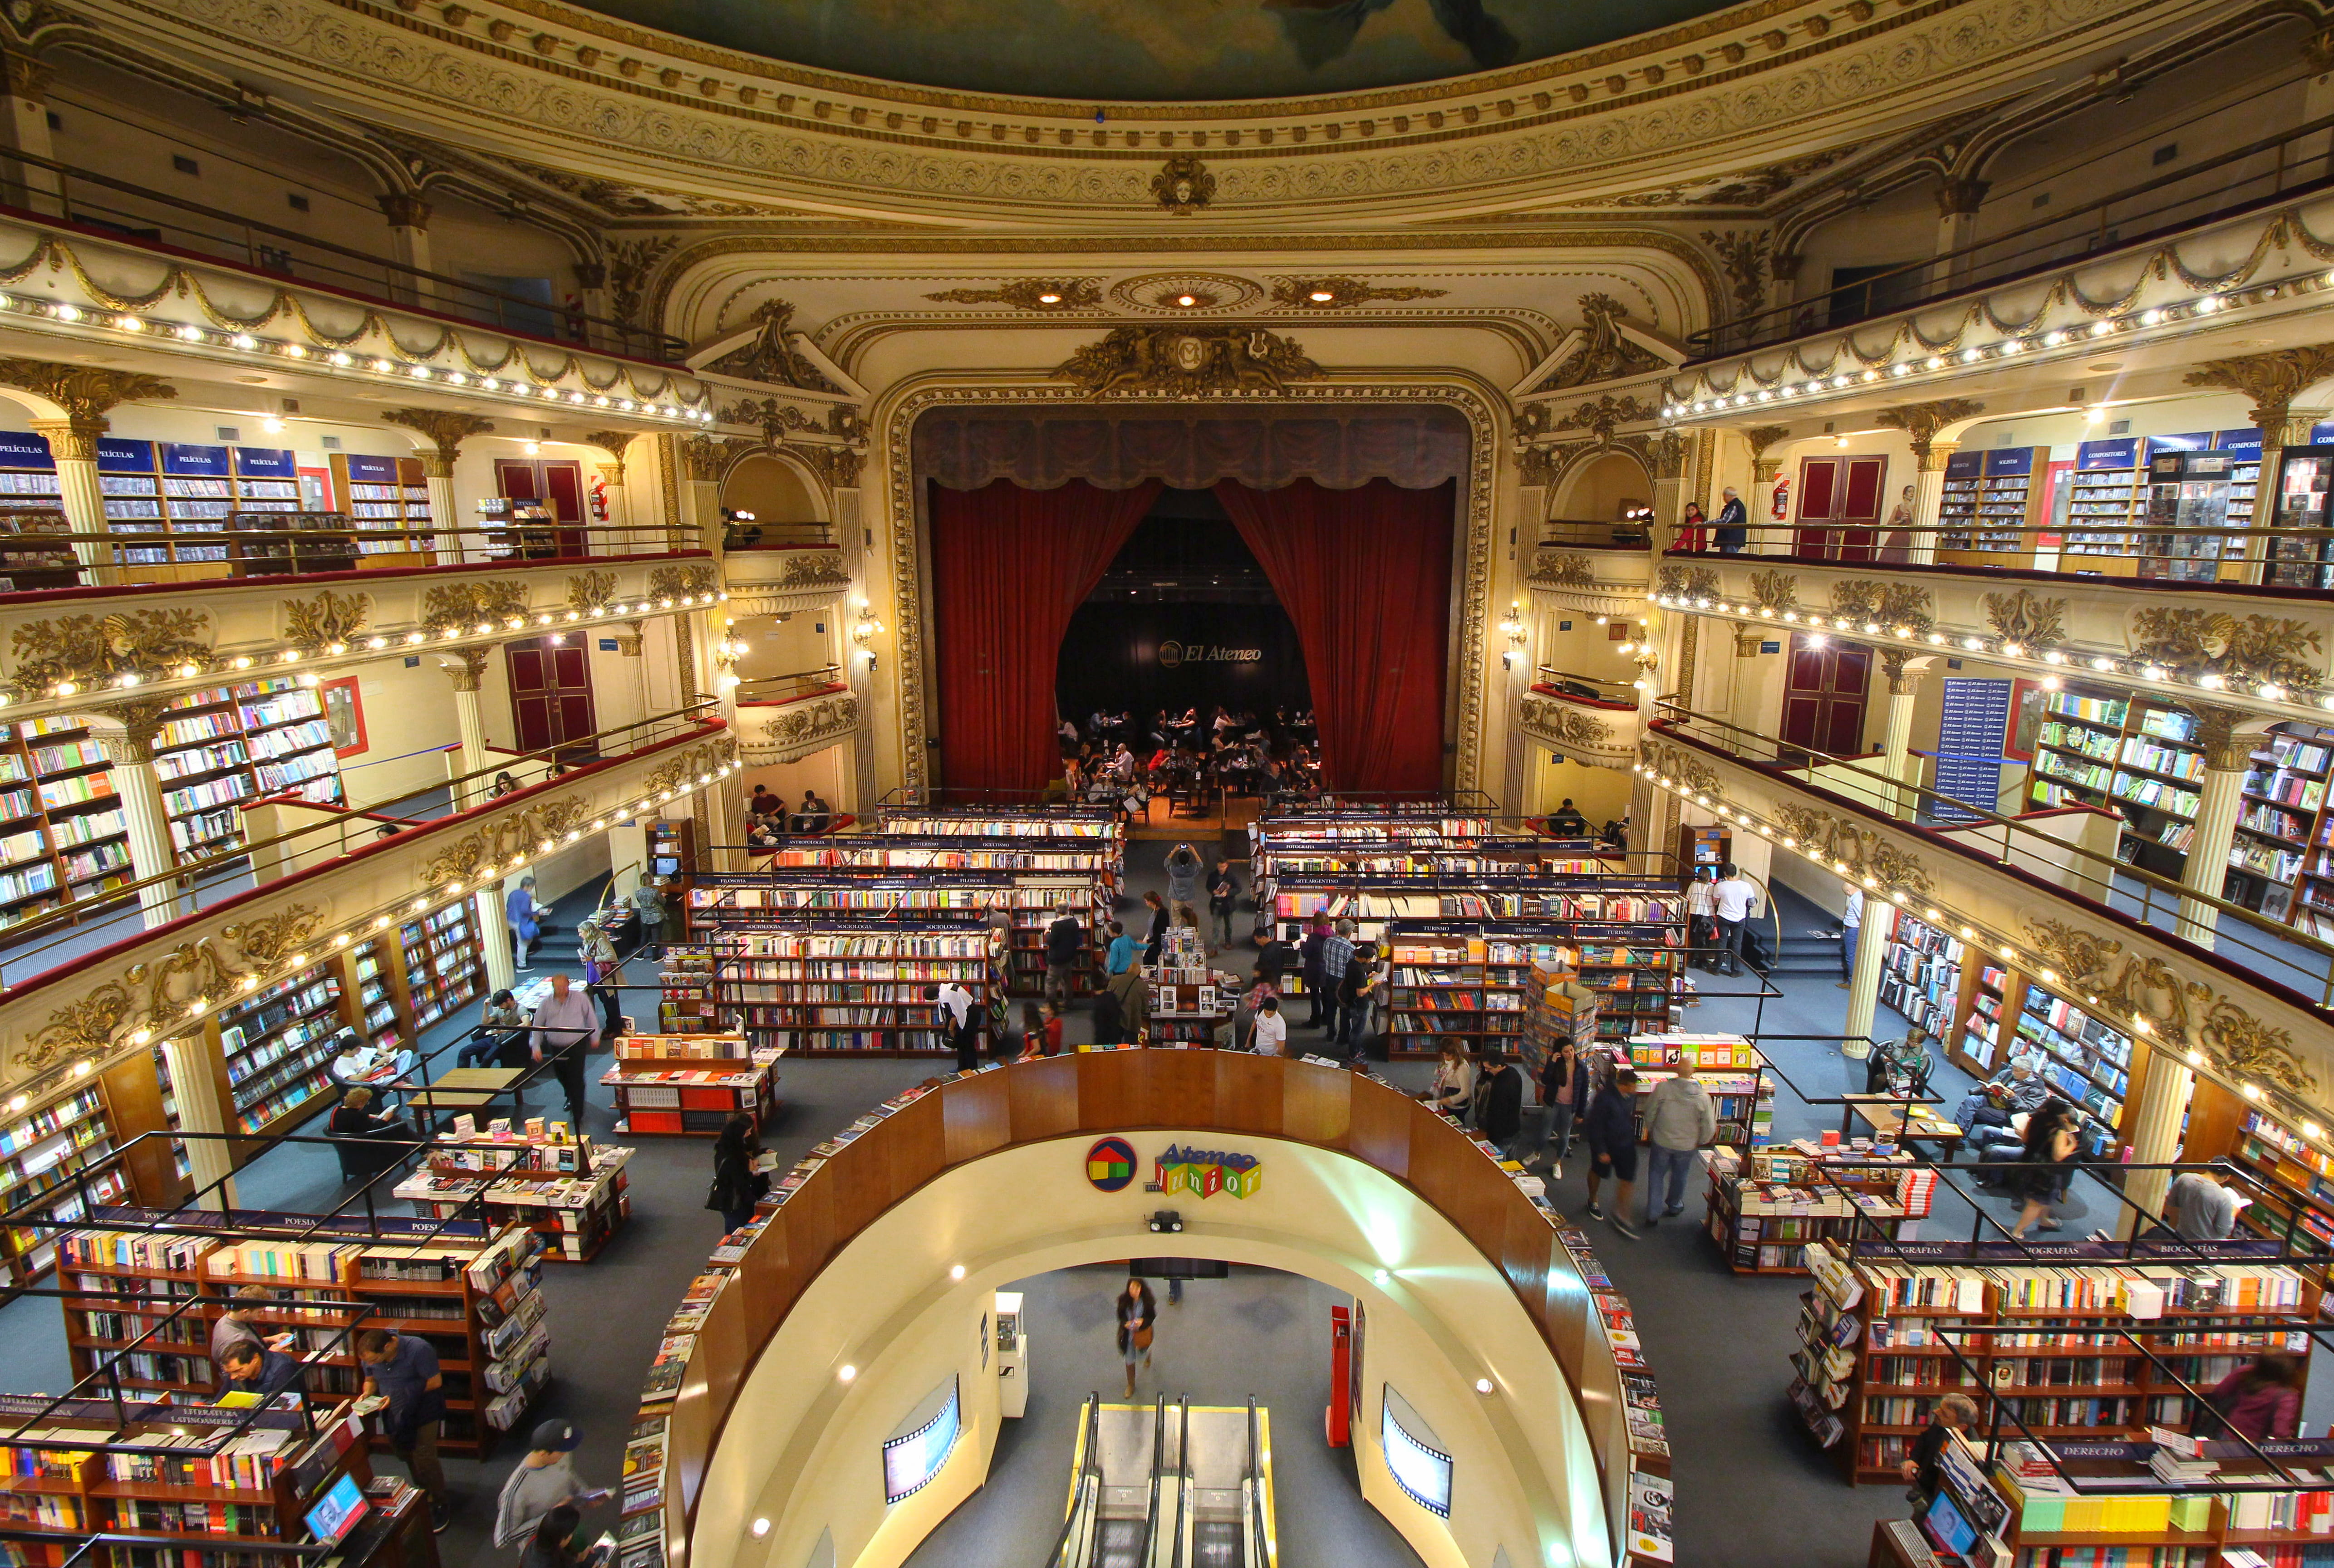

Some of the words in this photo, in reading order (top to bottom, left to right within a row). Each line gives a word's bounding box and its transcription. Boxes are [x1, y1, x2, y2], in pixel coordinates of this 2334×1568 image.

[0, 445, 42, 454] PELÍCULAS
[2154, 445, 2197, 453] COMPOSITORES
[2088, 451, 2127, 459] COMPOSITORES
[179, 456, 211, 464] PELÍCULAS
[1184, 647, 1203, 661] El
[1206, 645, 1261, 661] Ateneo
[1160, 1143, 1256, 1168] Ateneo
[1157, 1165, 1259, 1193] Junior
[2161, 1243, 2217, 1253] BIOGRFÍAS
[184, 1408, 237, 1417] LITERATURA
[2064, 1447, 2124, 1455] DERECHO
